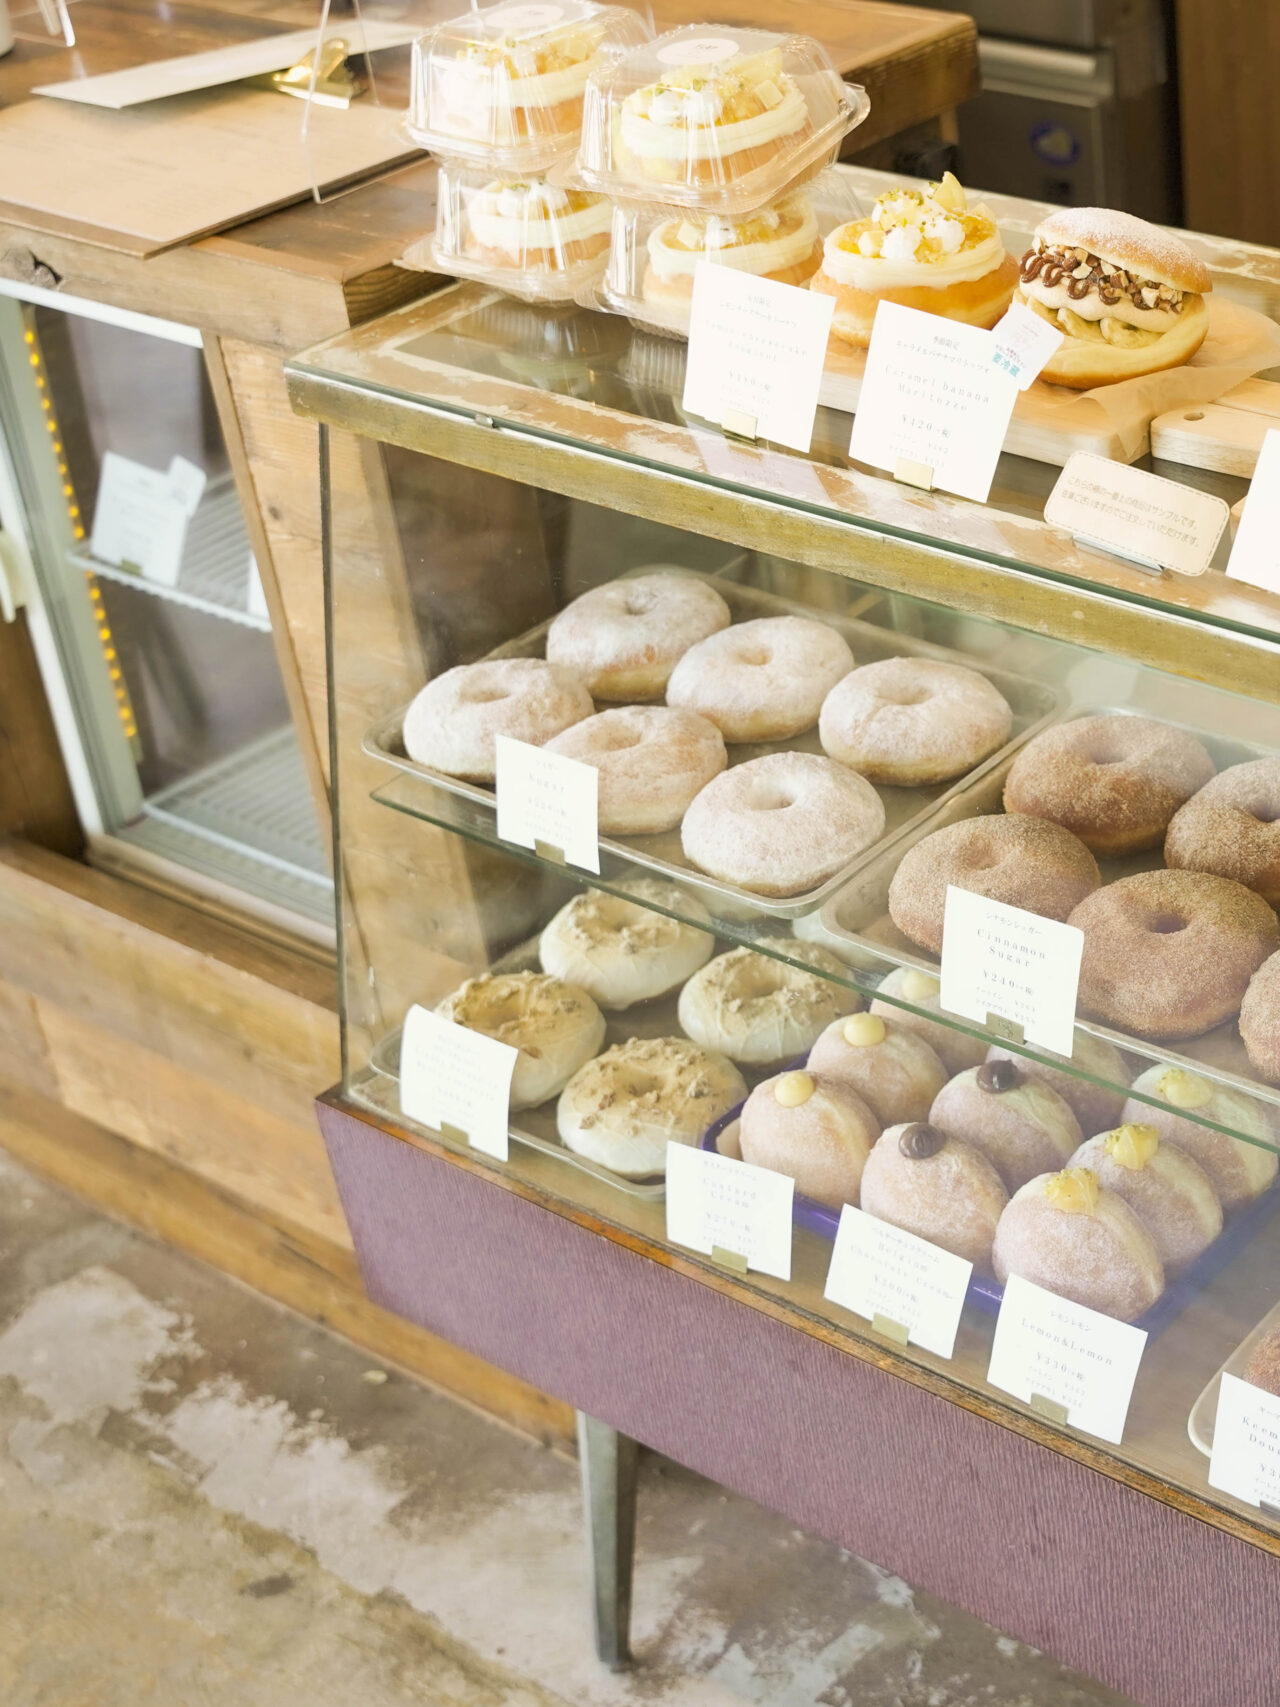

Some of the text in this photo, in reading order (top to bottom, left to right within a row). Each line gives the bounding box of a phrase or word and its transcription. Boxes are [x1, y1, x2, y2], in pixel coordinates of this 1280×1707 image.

[942, 381, 990, 404] banana
[976, 928, 1046, 960] Cinnamon
[989, 945, 1031, 968] Sugar
[1021, 1318, 1113, 1366] Lemon&Lemon
